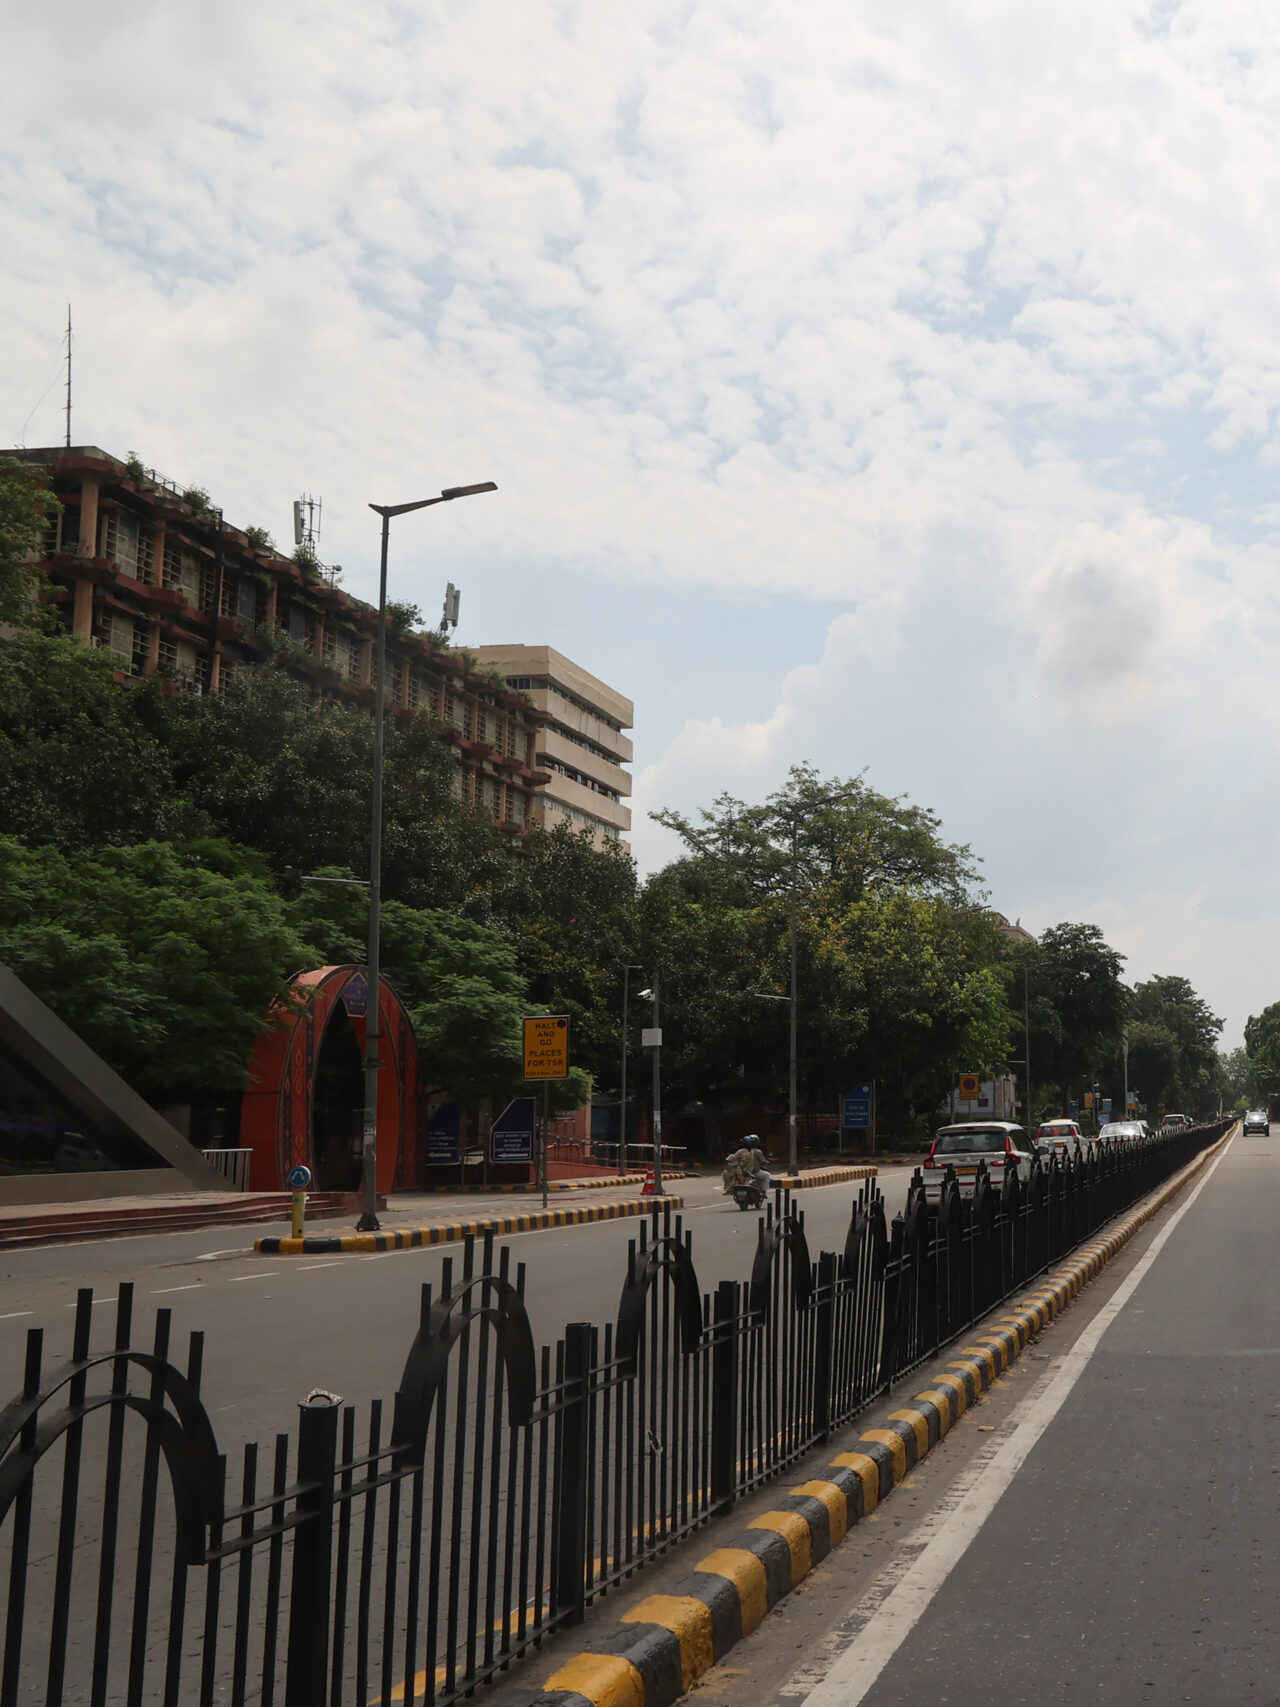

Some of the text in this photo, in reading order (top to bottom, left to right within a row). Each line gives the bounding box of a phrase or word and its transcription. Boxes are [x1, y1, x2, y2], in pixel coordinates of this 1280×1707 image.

[536, 1022, 556, 1030] HALT
[537, 1030, 555, 1038] AND
[529, 1049, 562, 1057] PLACES
[547, 1059, 563, 1067] TSR
